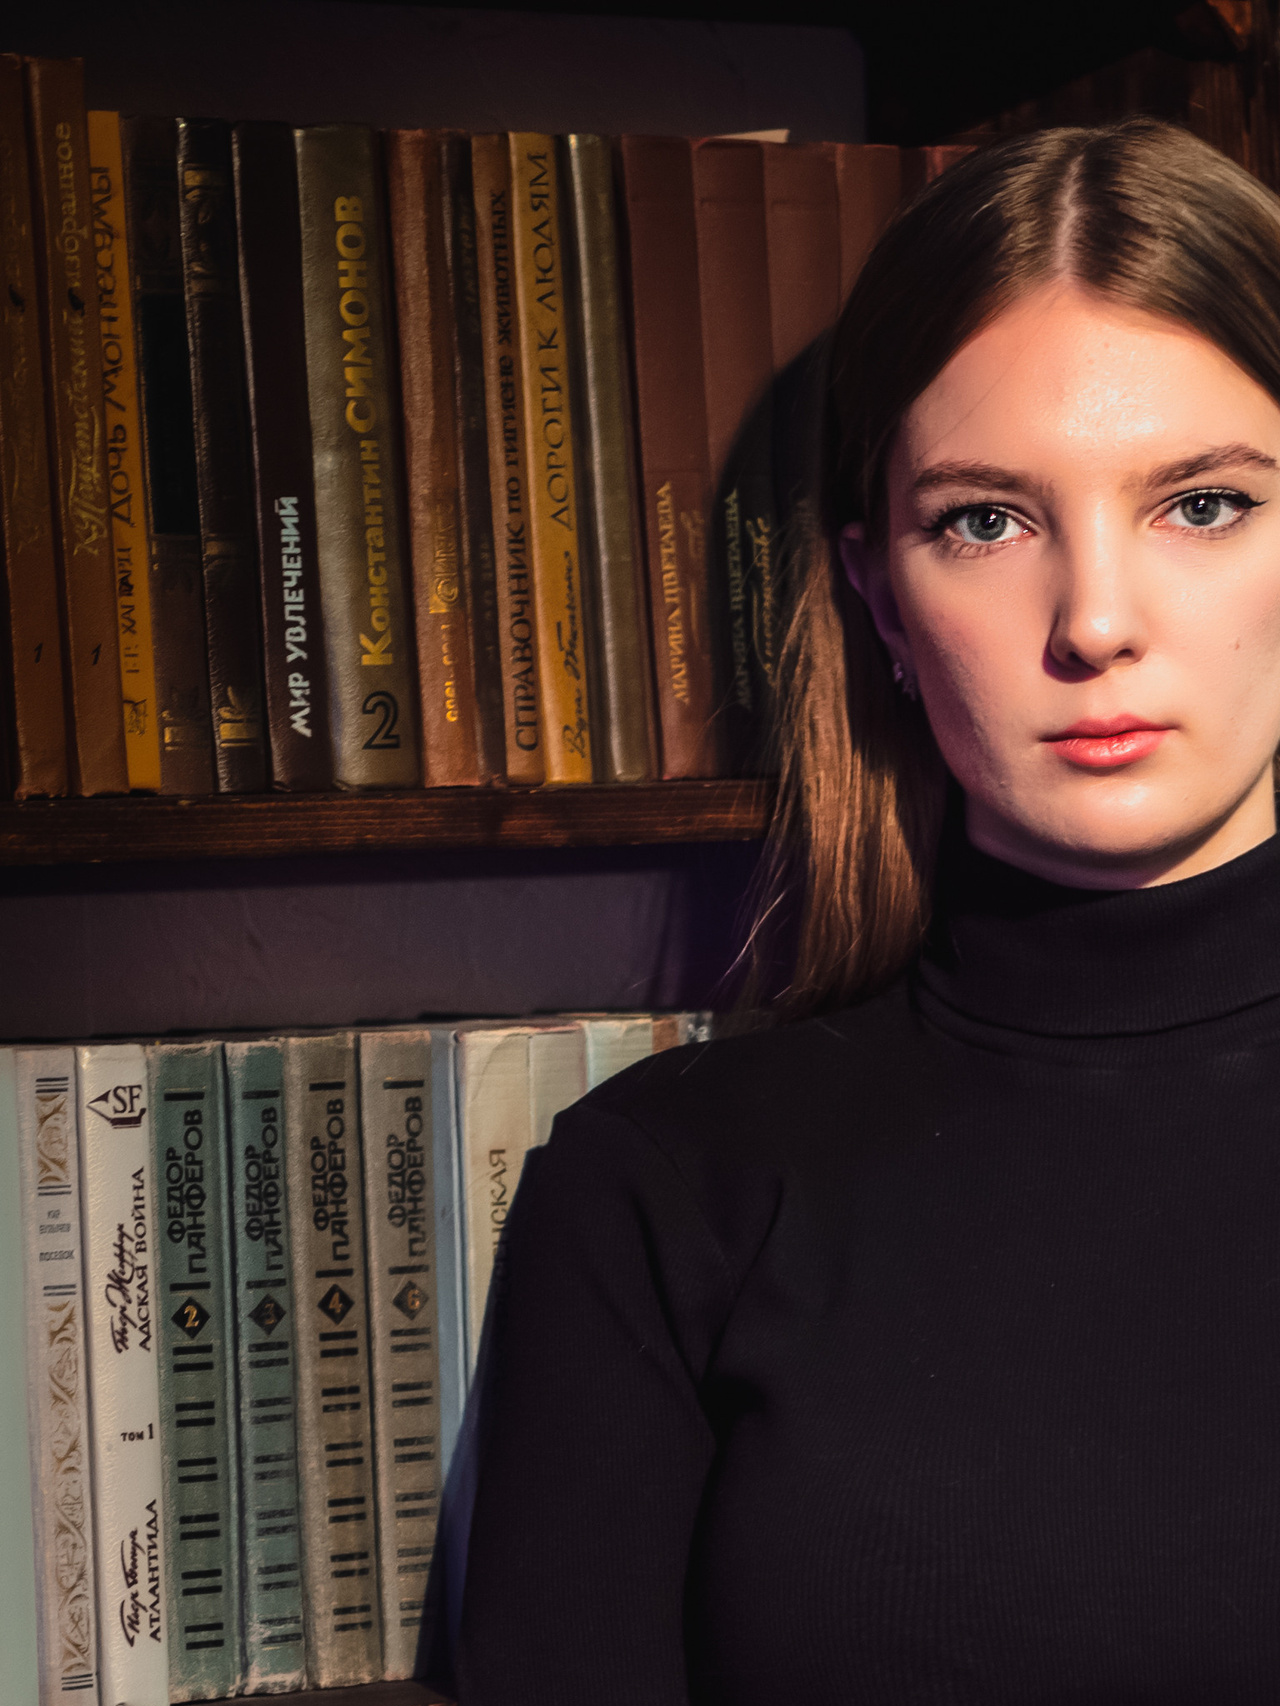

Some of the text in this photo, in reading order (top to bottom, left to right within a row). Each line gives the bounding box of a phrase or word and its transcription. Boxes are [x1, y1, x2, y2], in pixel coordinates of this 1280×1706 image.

[526, 151, 558, 313] ЛЮДЯМ
[536, 326, 559, 352] К
[106, 423, 136, 529] Дочь
[332, 195, 400, 751] 2 Константин СИМОНОВ
[490, 190, 539, 751] СПРАВОЧНИК по гигиене животных
[540, 365, 575, 532] ДОРОГИ
[273, 495, 313, 738] МИР УВЛЕЧЕНИЙ
[656, 481, 690, 705] МАРИНА ЦВЕТАЕВА
[724, 488, 746, 611] ЦВЕТАЕВА
[111, 1084, 143, 1114] SF
[166, 1147, 186, 1244] ФЕДОР
[183, 1108, 207, 1276] ПАНФЕРОВ
[244, 1144, 264, 1243] ФЕДОР
[261, 1106, 284, 1272] ПАНФЕРОВ
[310, 1135, 330, 1232] ФЕДОР
[326, 1100, 349, 1261] ПАНФЕРОВ
[386, 1133, 406, 1230] ФЕДОР
[404, 1096, 428, 1259] ПАНФЕРОВ
[125, 1166, 152, 1353] АДСКАЯ ВОЙНА
[183, 1305, 200, 1328] 2
[327, 1292, 344, 1315] 4
[145, 1498, 161, 1643] АТЛАНТИДА
